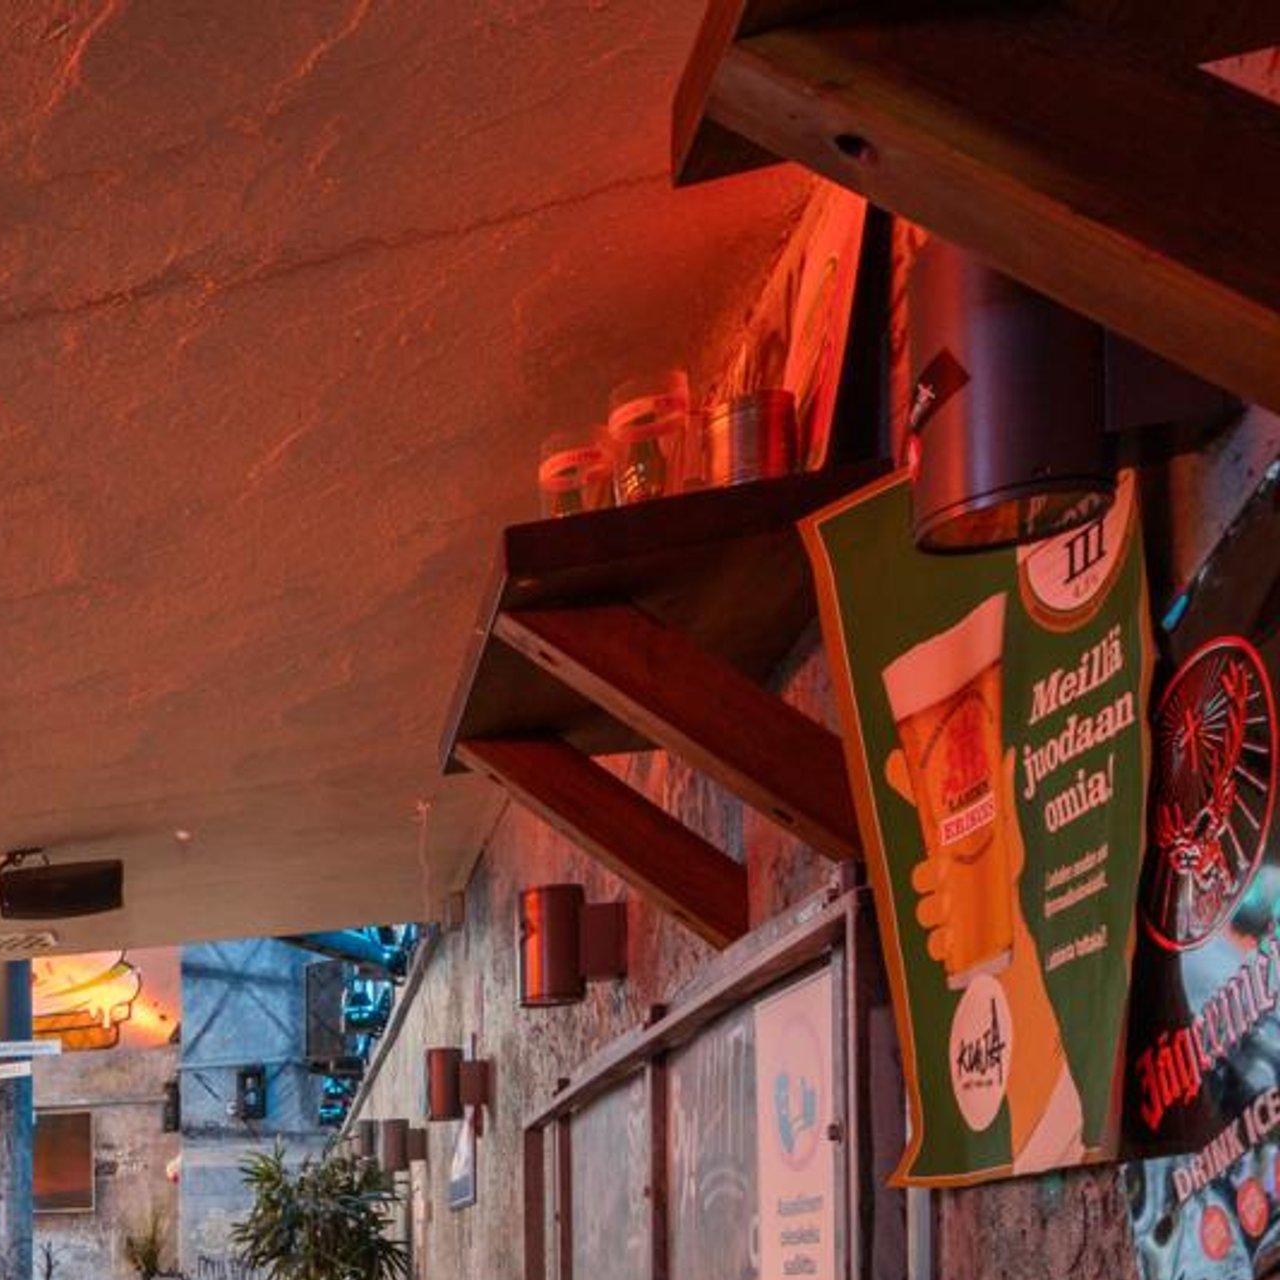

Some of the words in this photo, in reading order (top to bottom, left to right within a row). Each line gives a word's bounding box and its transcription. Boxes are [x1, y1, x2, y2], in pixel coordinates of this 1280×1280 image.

[1029, 624, 1123, 726] Meillä
[1023, 691, 1135, 799] juodaan
[1044, 753, 1114, 832] omia!
[1173, 1117, 1244, 1201] DRINK
